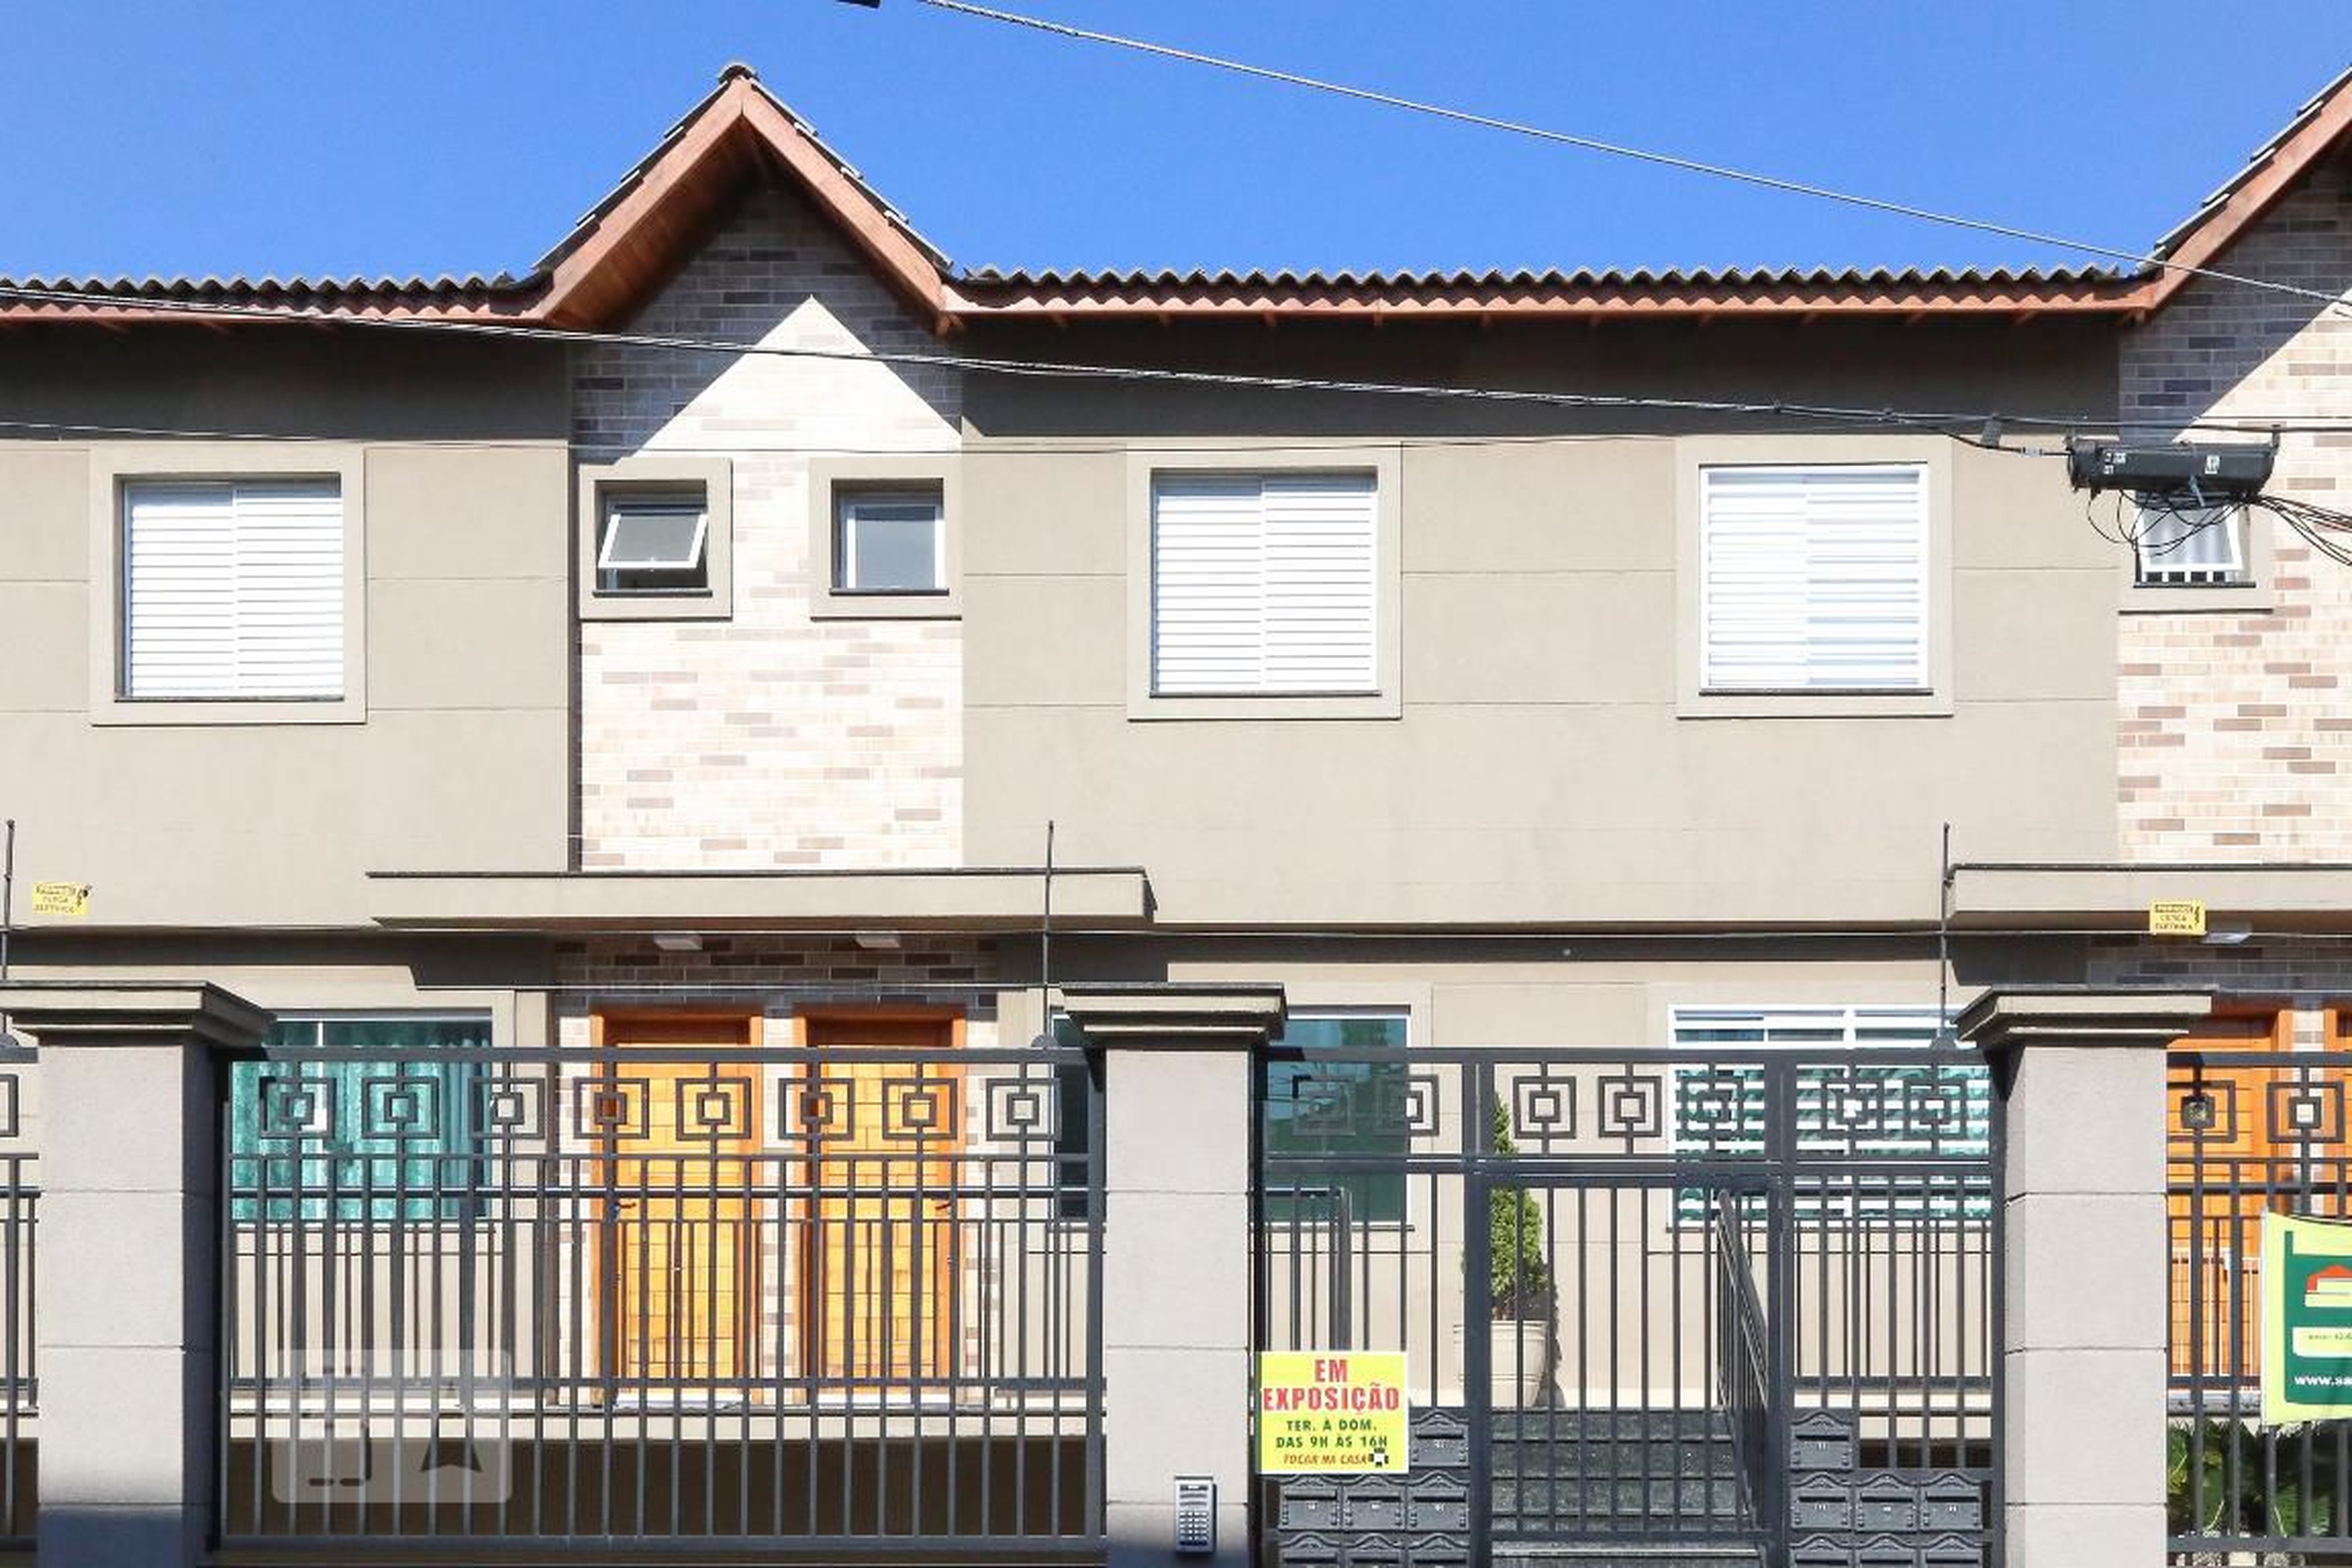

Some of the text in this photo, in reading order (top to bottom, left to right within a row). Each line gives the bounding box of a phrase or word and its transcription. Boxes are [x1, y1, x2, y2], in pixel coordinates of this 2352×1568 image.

[1314, 1359, 1348, 1382] EM
[1263, 1382, 1400, 1414] EXPOSIÇÃO
[1286, 1420, 1316, 1431] TER.
[1338, 1419, 1377, 1431] DOM.
[1276, 1436, 1303, 1448] DAS
[1310, 1436, 1328, 1448] 9H
[1360, 1436, 1388, 1447] 16H
